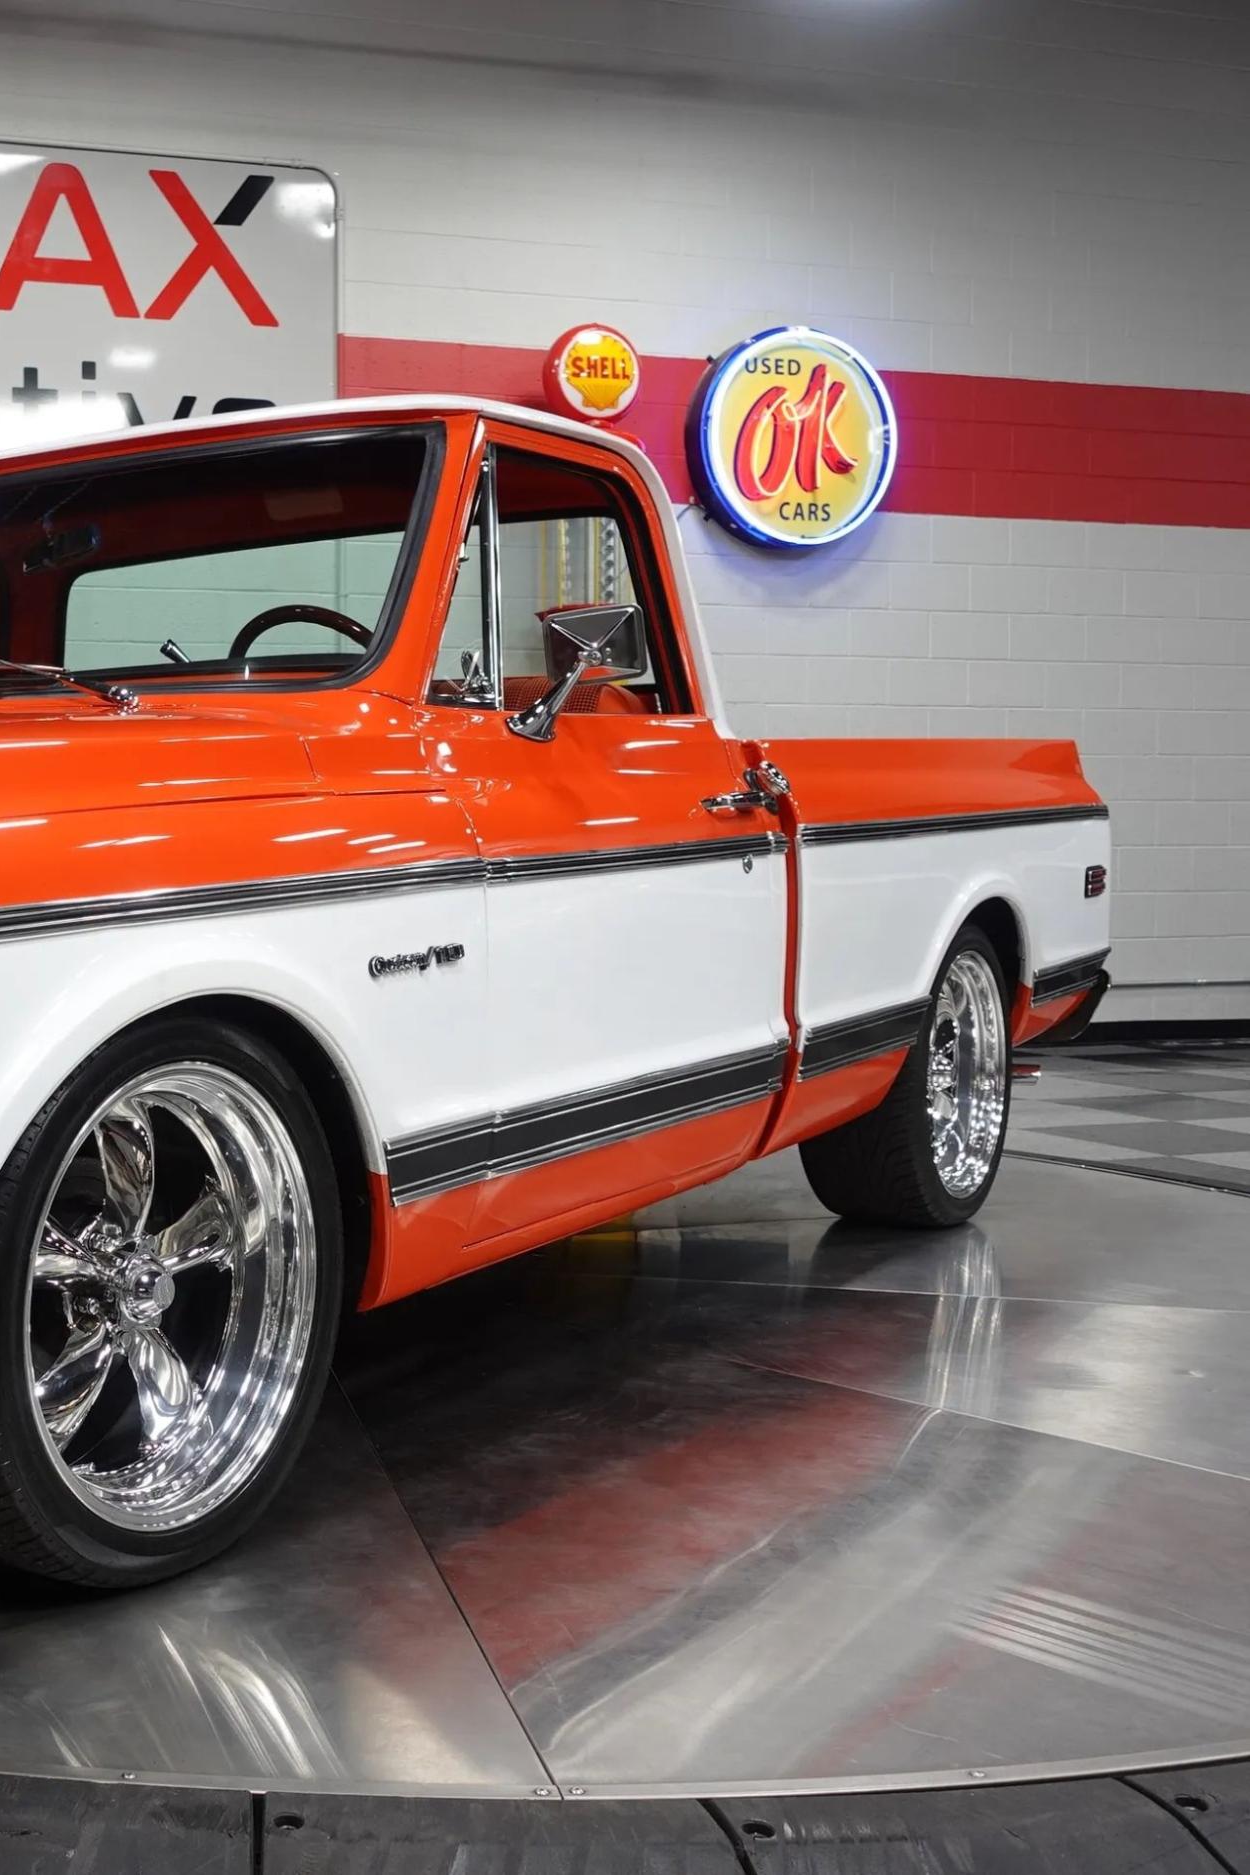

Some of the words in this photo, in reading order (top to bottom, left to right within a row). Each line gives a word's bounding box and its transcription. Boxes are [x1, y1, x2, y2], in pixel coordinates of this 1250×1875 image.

[571, 355, 630, 380] SHELL
[745, 357, 802, 377] USED
[734, 363, 859, 501] OK
[779, 501, 831, 523] CARS
